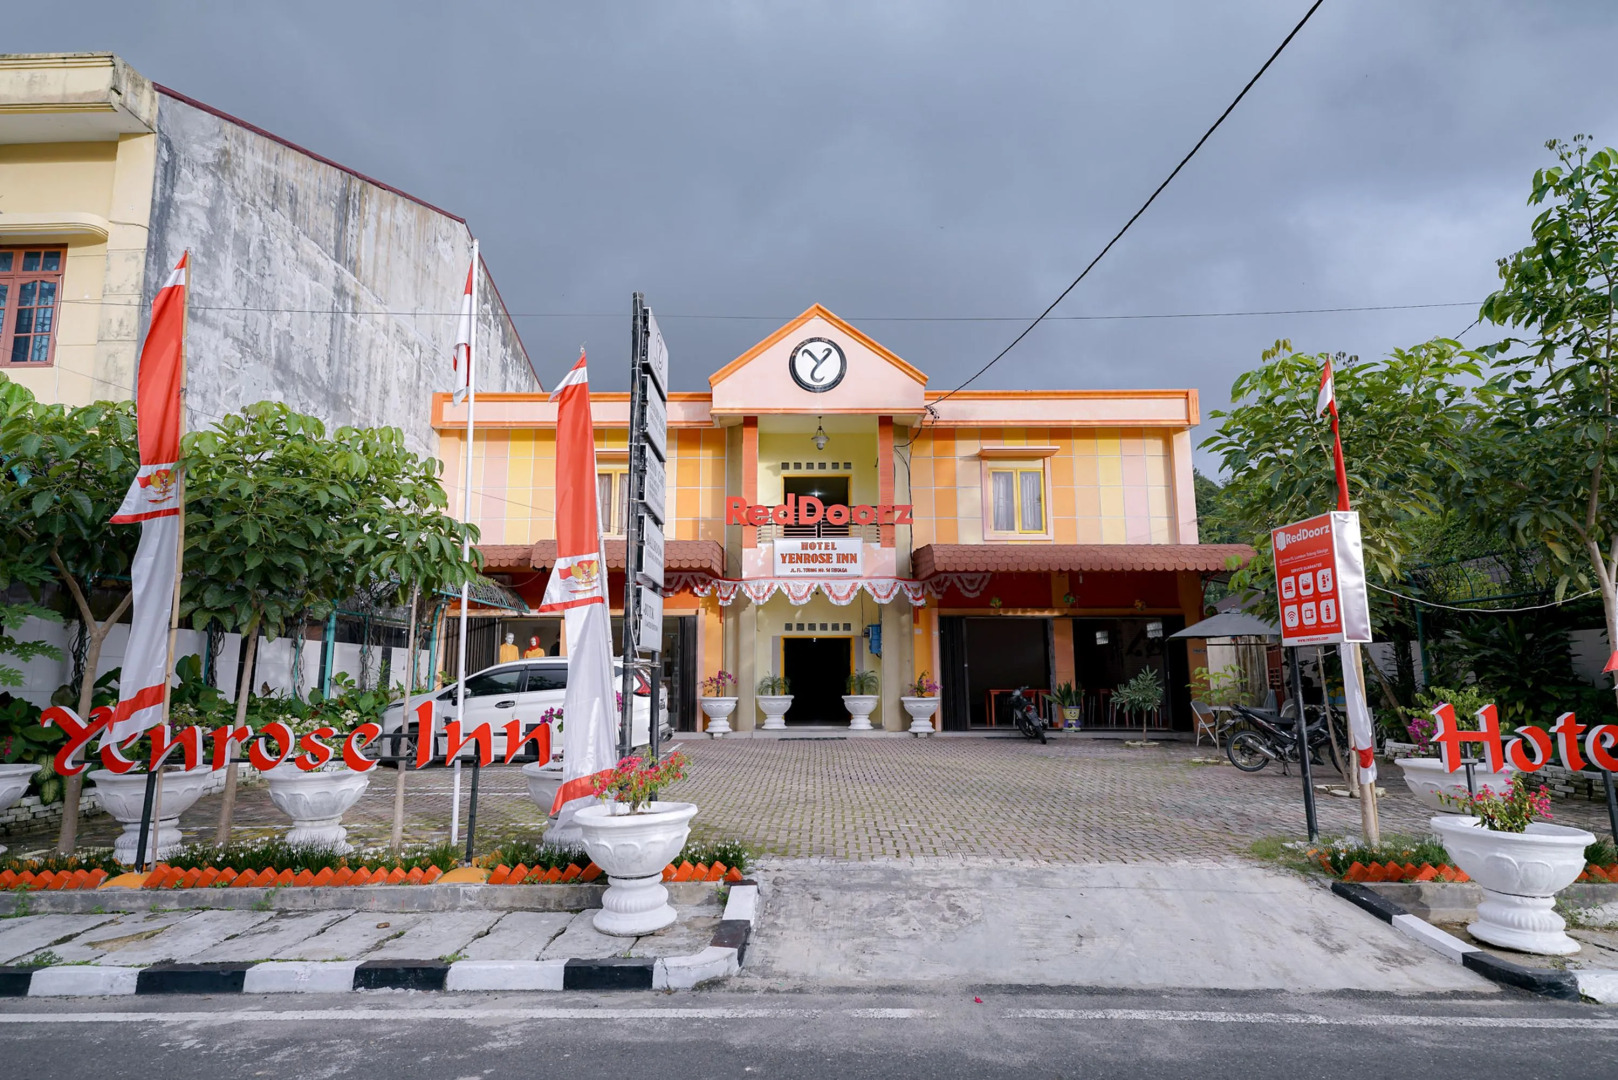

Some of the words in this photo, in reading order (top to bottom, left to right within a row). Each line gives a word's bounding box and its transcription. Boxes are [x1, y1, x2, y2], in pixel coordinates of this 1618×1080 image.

[802, 347, 833, 383] Y
[726, 493, 914, 526] RedDoorz
[801, 542, 837, 551] HOTEL
[1286, 523, 1330, 544] RedDoorz
[780, 553, 833, 564] YENROSE
[836, 553, 858, 564] INN
[40, 705, 383, 776] Yenrose
[415, 700, 553, 769] Inn
